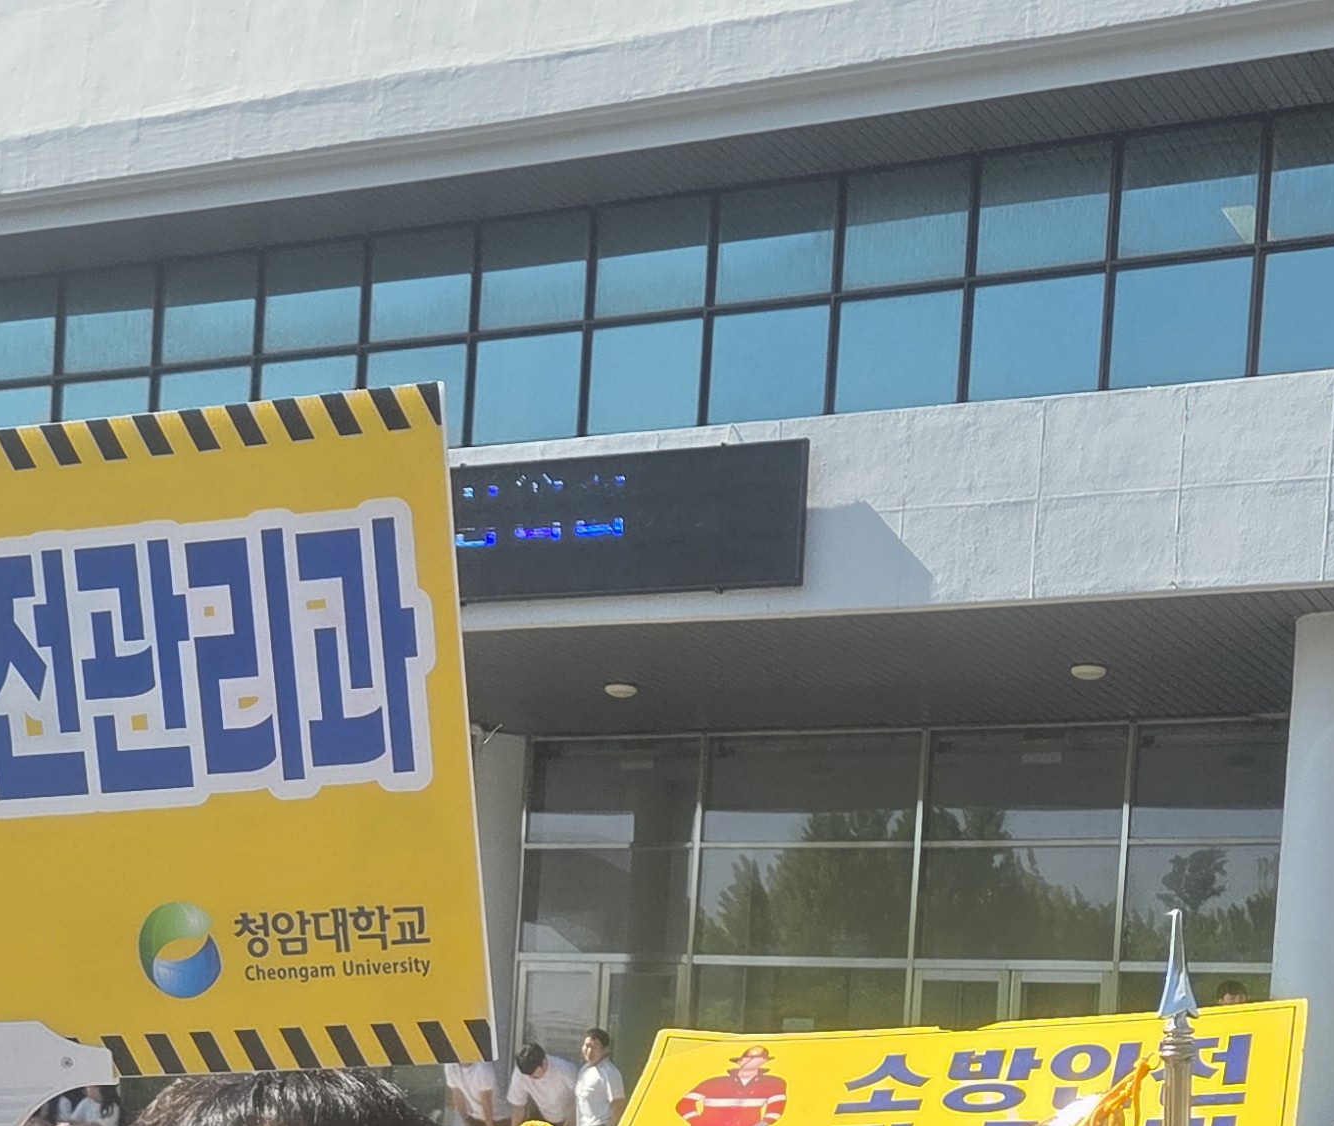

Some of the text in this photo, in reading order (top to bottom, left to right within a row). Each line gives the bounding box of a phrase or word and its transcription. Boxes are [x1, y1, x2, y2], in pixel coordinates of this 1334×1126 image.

[233, 904, 432, 958] 청암대학교
[244, 956, 431, 983] Cheongam University
[833, 1033, 1254, 1116] 소방안전
